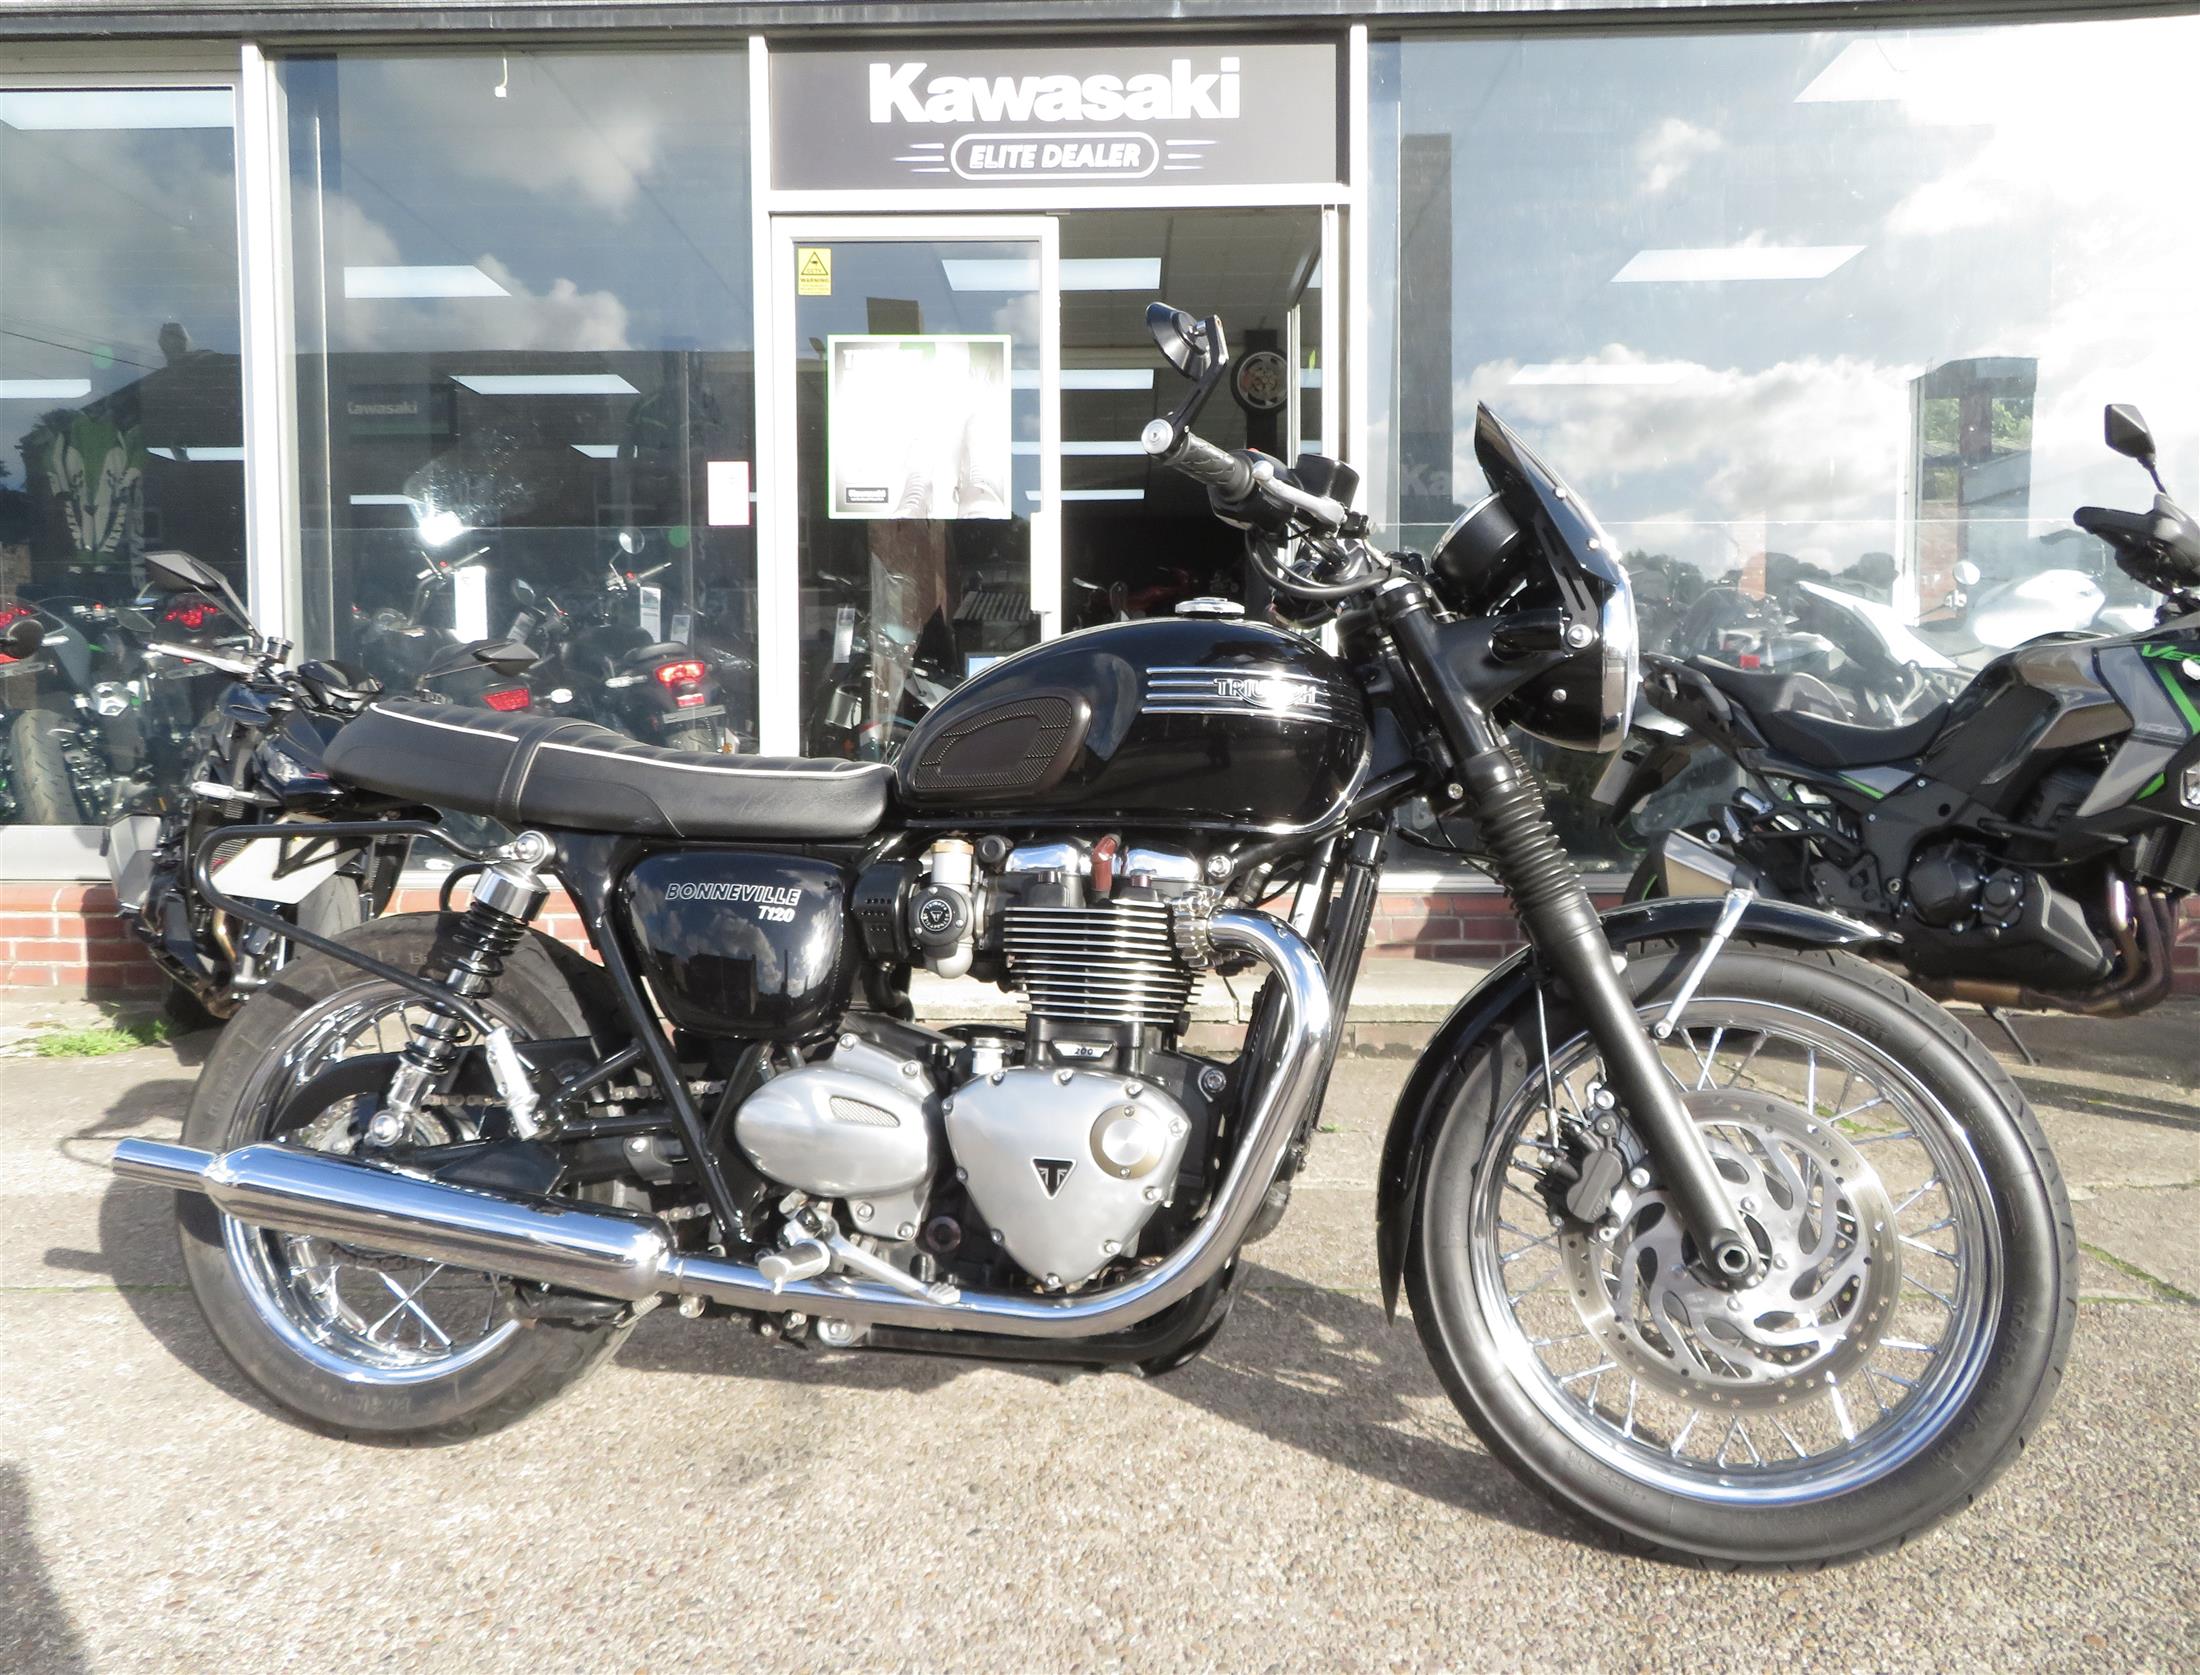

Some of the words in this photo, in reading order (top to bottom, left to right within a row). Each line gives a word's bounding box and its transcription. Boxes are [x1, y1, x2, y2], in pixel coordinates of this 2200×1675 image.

[869, 57, 1240, 123] Kawasaki
[969, 144, 1037, 169] ELITE
[1041, 143, 1141, 168] DEALER
[1214, 678, 1317, 709] TRIUH
[665, 882, 802, 906] BONNEVILLE
[758, 905, 796, 923] T120
